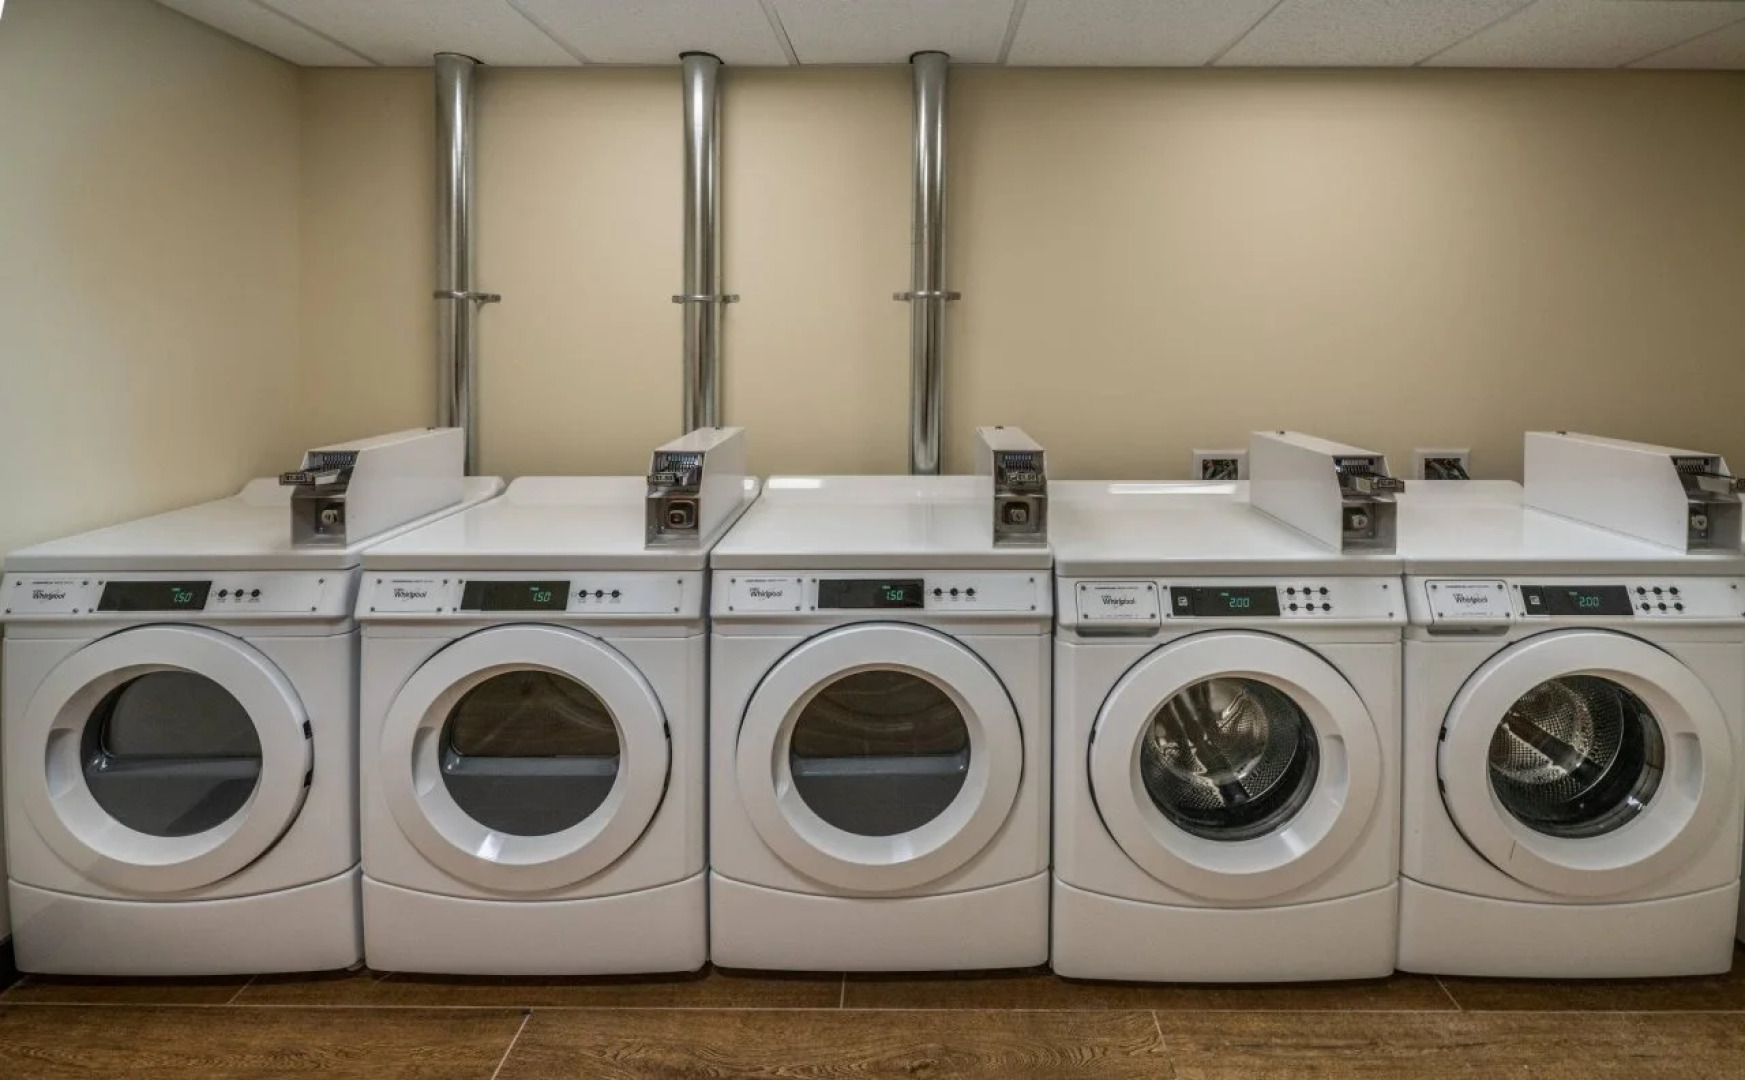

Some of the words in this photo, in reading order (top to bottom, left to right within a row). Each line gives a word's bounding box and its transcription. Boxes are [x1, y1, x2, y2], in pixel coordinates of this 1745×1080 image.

[32, 591, 66, 600] Whirlpool
[394, 590, 427, 599] Whirlpool
[750, 590, 783, 599] Whirlpool
[1102, 597, 1135, 606] Whirlpool
[1454, 595, 1488, 604] Whirlpool
